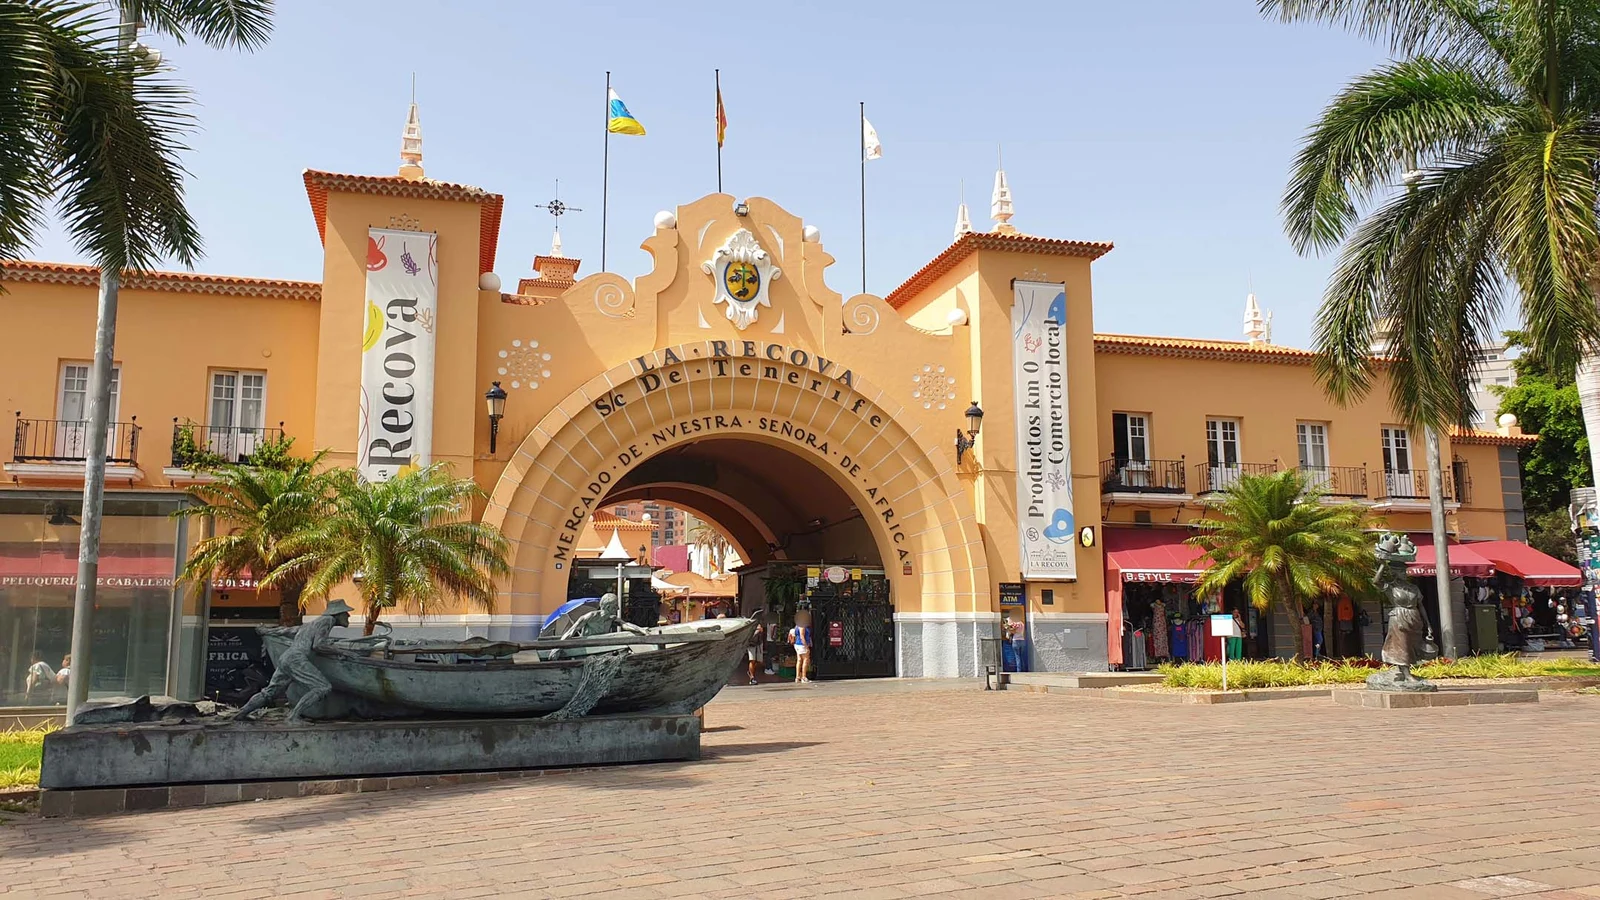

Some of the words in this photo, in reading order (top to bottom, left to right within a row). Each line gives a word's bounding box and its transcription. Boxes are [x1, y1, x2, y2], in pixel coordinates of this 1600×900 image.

[636, 348, 681, 373] LA
[711, 340, 853, 388] RECOVA
[1044, 320, 1060, 365] local
[368, 297, 418, 468] Recova
[595, 391, 627, 417] S/c
[640, 369, 682, 393] De
[713, 359, 882, 428] Tenerife
[1025, 381, 1040, 408] km
[1046, 372, 1064, 464] Comercio
[554, 471, 611, 561] MERCADO
[618, 444, 642, 466] DE
[652, 415, 742, 445] NVESTRA
[759, 418, 828, 455] SEÑORA
[840, 455, 861, 477] DE
[866, 487, 909, 560] AFRICA
[1027, 415, 1044, 518] Productos
[2, 575, 78, 587] PELUQUERÍ
[226, 580, 236, 588] 01
[239, 580, 250, 588] 34
[1126, 572, 1171, 581] B.STYLE
[208, 652, 250, 661] FRICA
